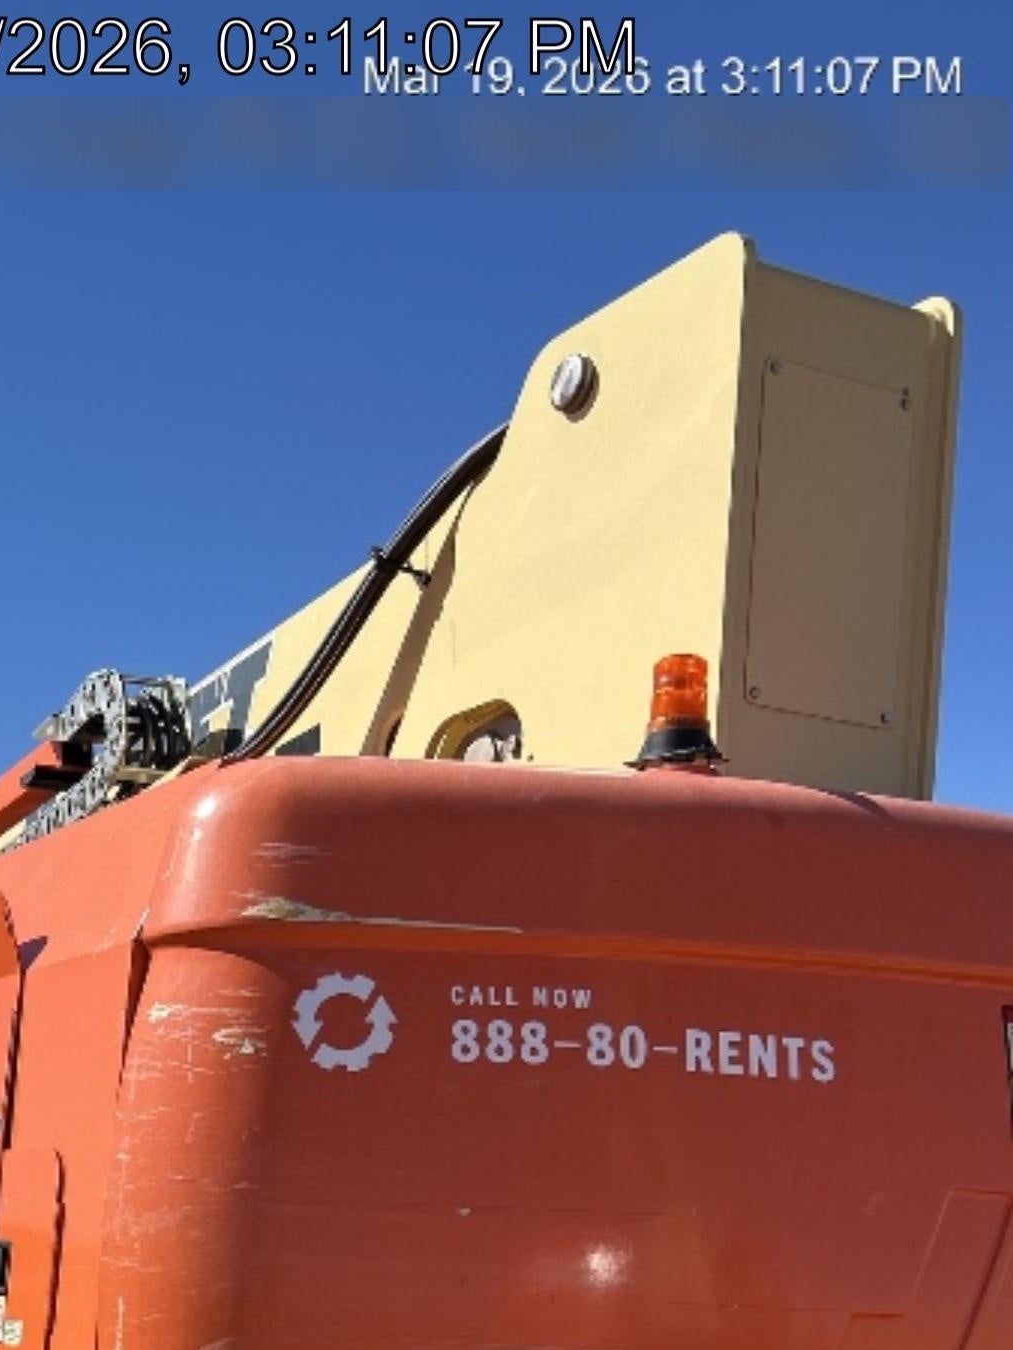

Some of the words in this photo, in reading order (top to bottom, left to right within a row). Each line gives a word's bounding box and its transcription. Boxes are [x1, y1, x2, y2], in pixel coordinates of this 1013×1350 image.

[450, 985, 519, 1006] CALL
[532, 986, 592, 1009] NOW
[450, 1018, 836, 1082] 888-80-RENTS
